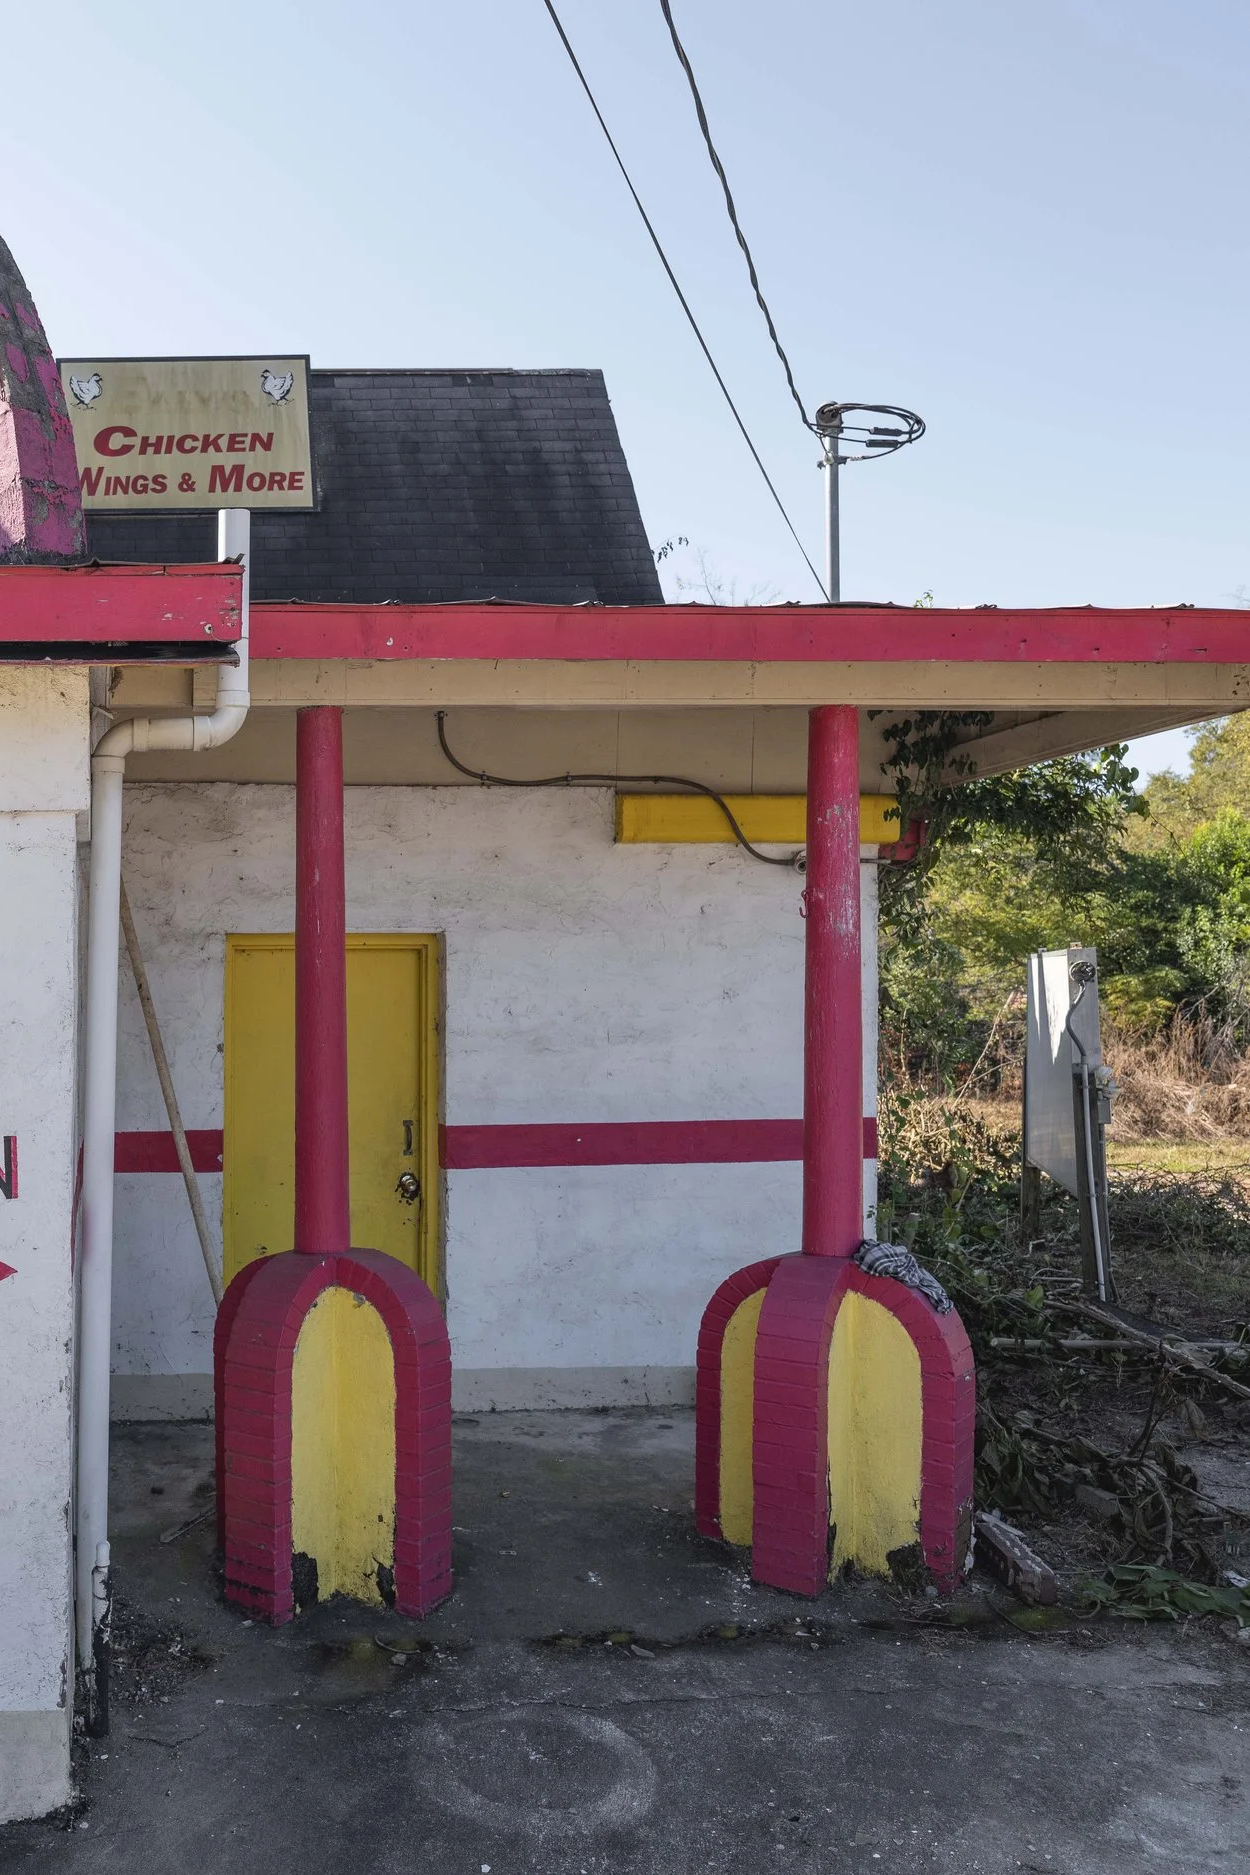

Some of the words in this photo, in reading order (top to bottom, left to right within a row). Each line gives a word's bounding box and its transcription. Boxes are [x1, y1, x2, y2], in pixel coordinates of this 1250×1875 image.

[93, 425, 275, 457] CHICKEN
[177, 472, 197, 493] &
[208, 464, 305, 493] MORE
